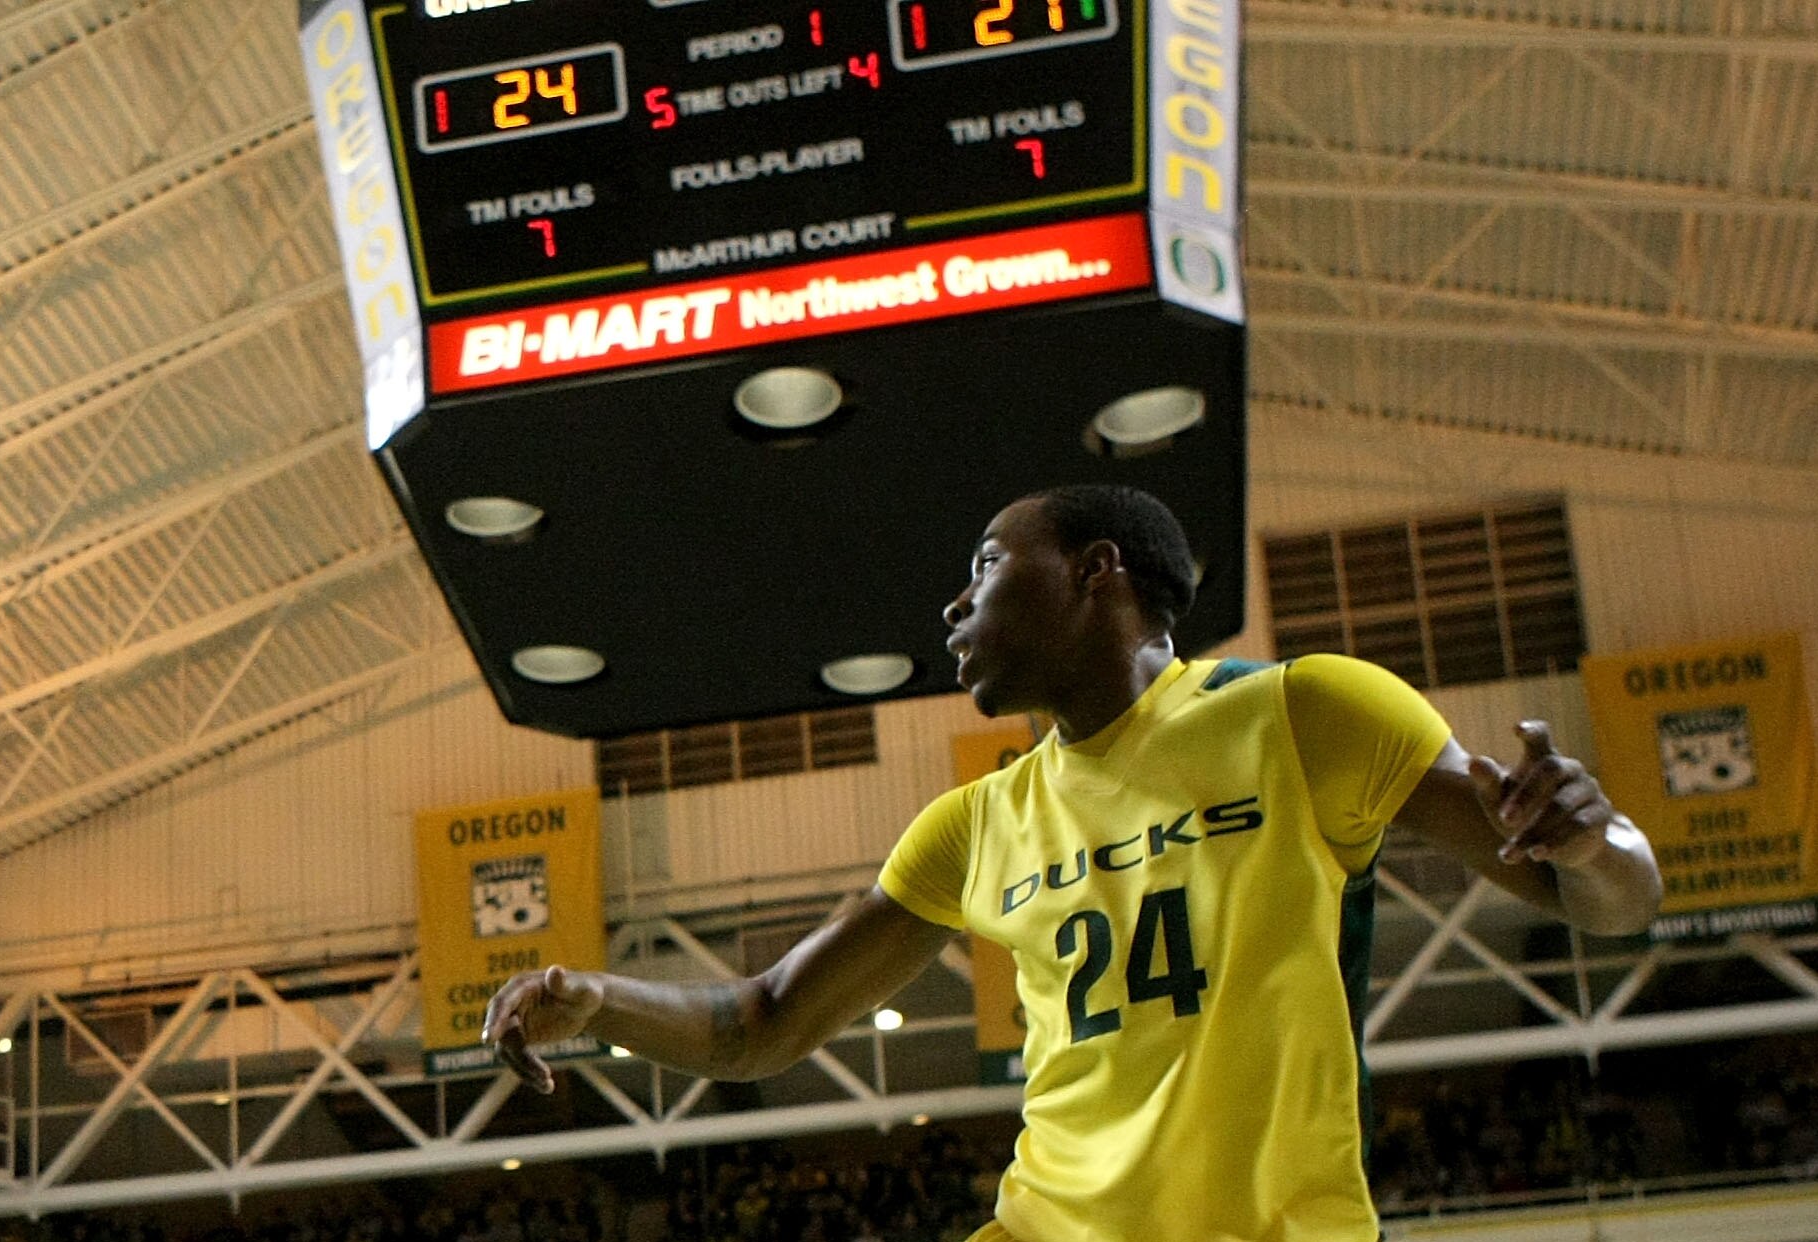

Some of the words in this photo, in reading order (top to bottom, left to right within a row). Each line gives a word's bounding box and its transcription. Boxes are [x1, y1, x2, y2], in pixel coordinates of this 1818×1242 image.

[686, 24, 784, 63] PERIOD
[676, 87, 725, 117] TIME
[727, 75, 788, 108] OUTS
[789, 64, 845, 97] LEFT
[848, 51, 880, 89] 4
[492, 63, 578, 129] 24
[643, 86, 677, 130] 5
[946, 117, 990, 146] TM
[994, 101, 1085, 137] FOULS
[669, 137, 864, 192] FOULS-PLAYER
[1015, 139, 1045, 178] 7
[467, 199, 507, 226] TM
[510, 183, 596, 220] FOULS
[527, 219, 556, 258] 7
[654, 232, 796, 275] McARTHUR
[801, 212, 896, 250] COURT
[738, 264, 939, 331] Northwest
[1624, 653, 1769, 698] OREGON
[448, 805, 568, 847] OREGON
[1001, 795, 1263, 917] DUCKS
[1055, 885, 1208, 1045] 24
